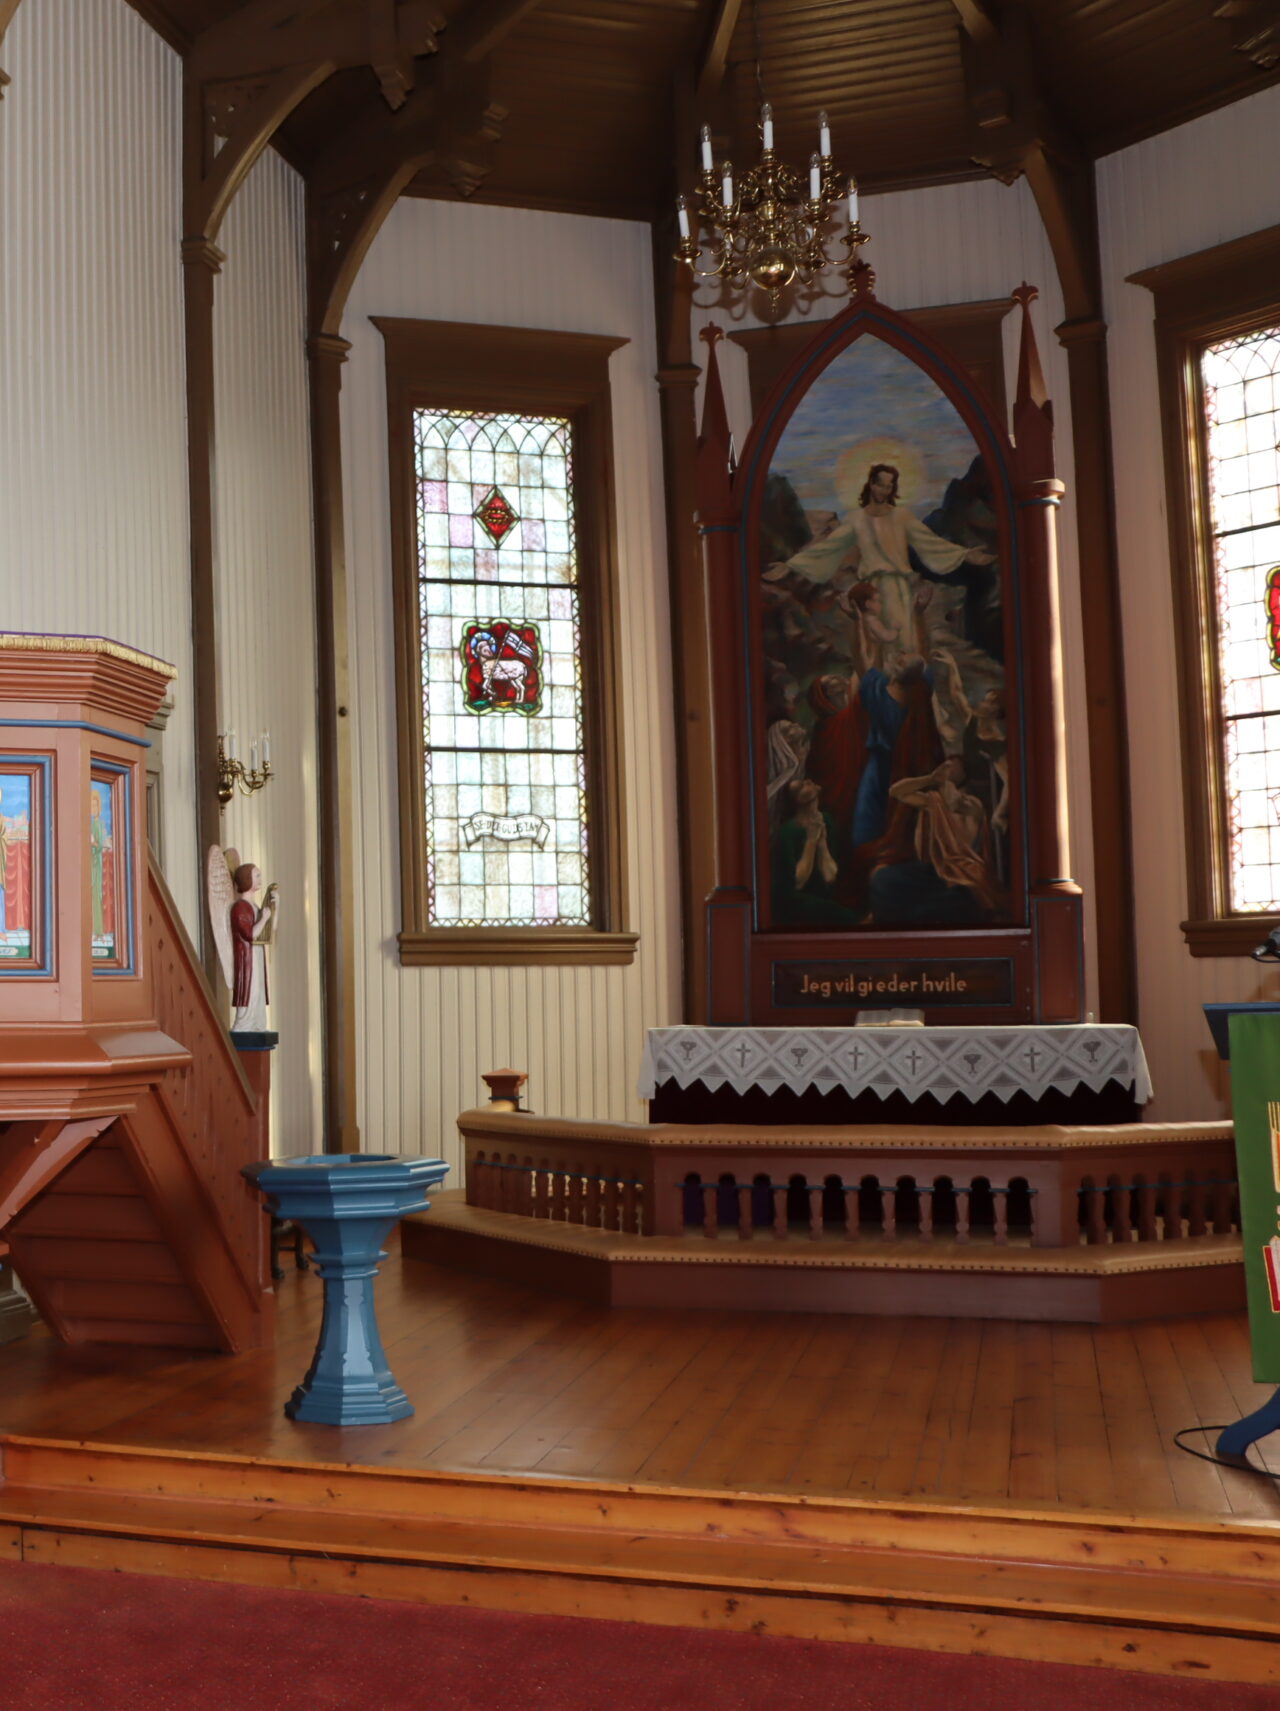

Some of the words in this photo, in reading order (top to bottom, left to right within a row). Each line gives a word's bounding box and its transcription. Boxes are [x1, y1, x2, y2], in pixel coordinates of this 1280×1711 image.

[800, 974, 831, 998] Jeg
[835, 973, 854, 993] vil
[858, 976, 873, 997] gi
[876, 973, 919, 993] eder
[922, 971, 968, 993] hvile
